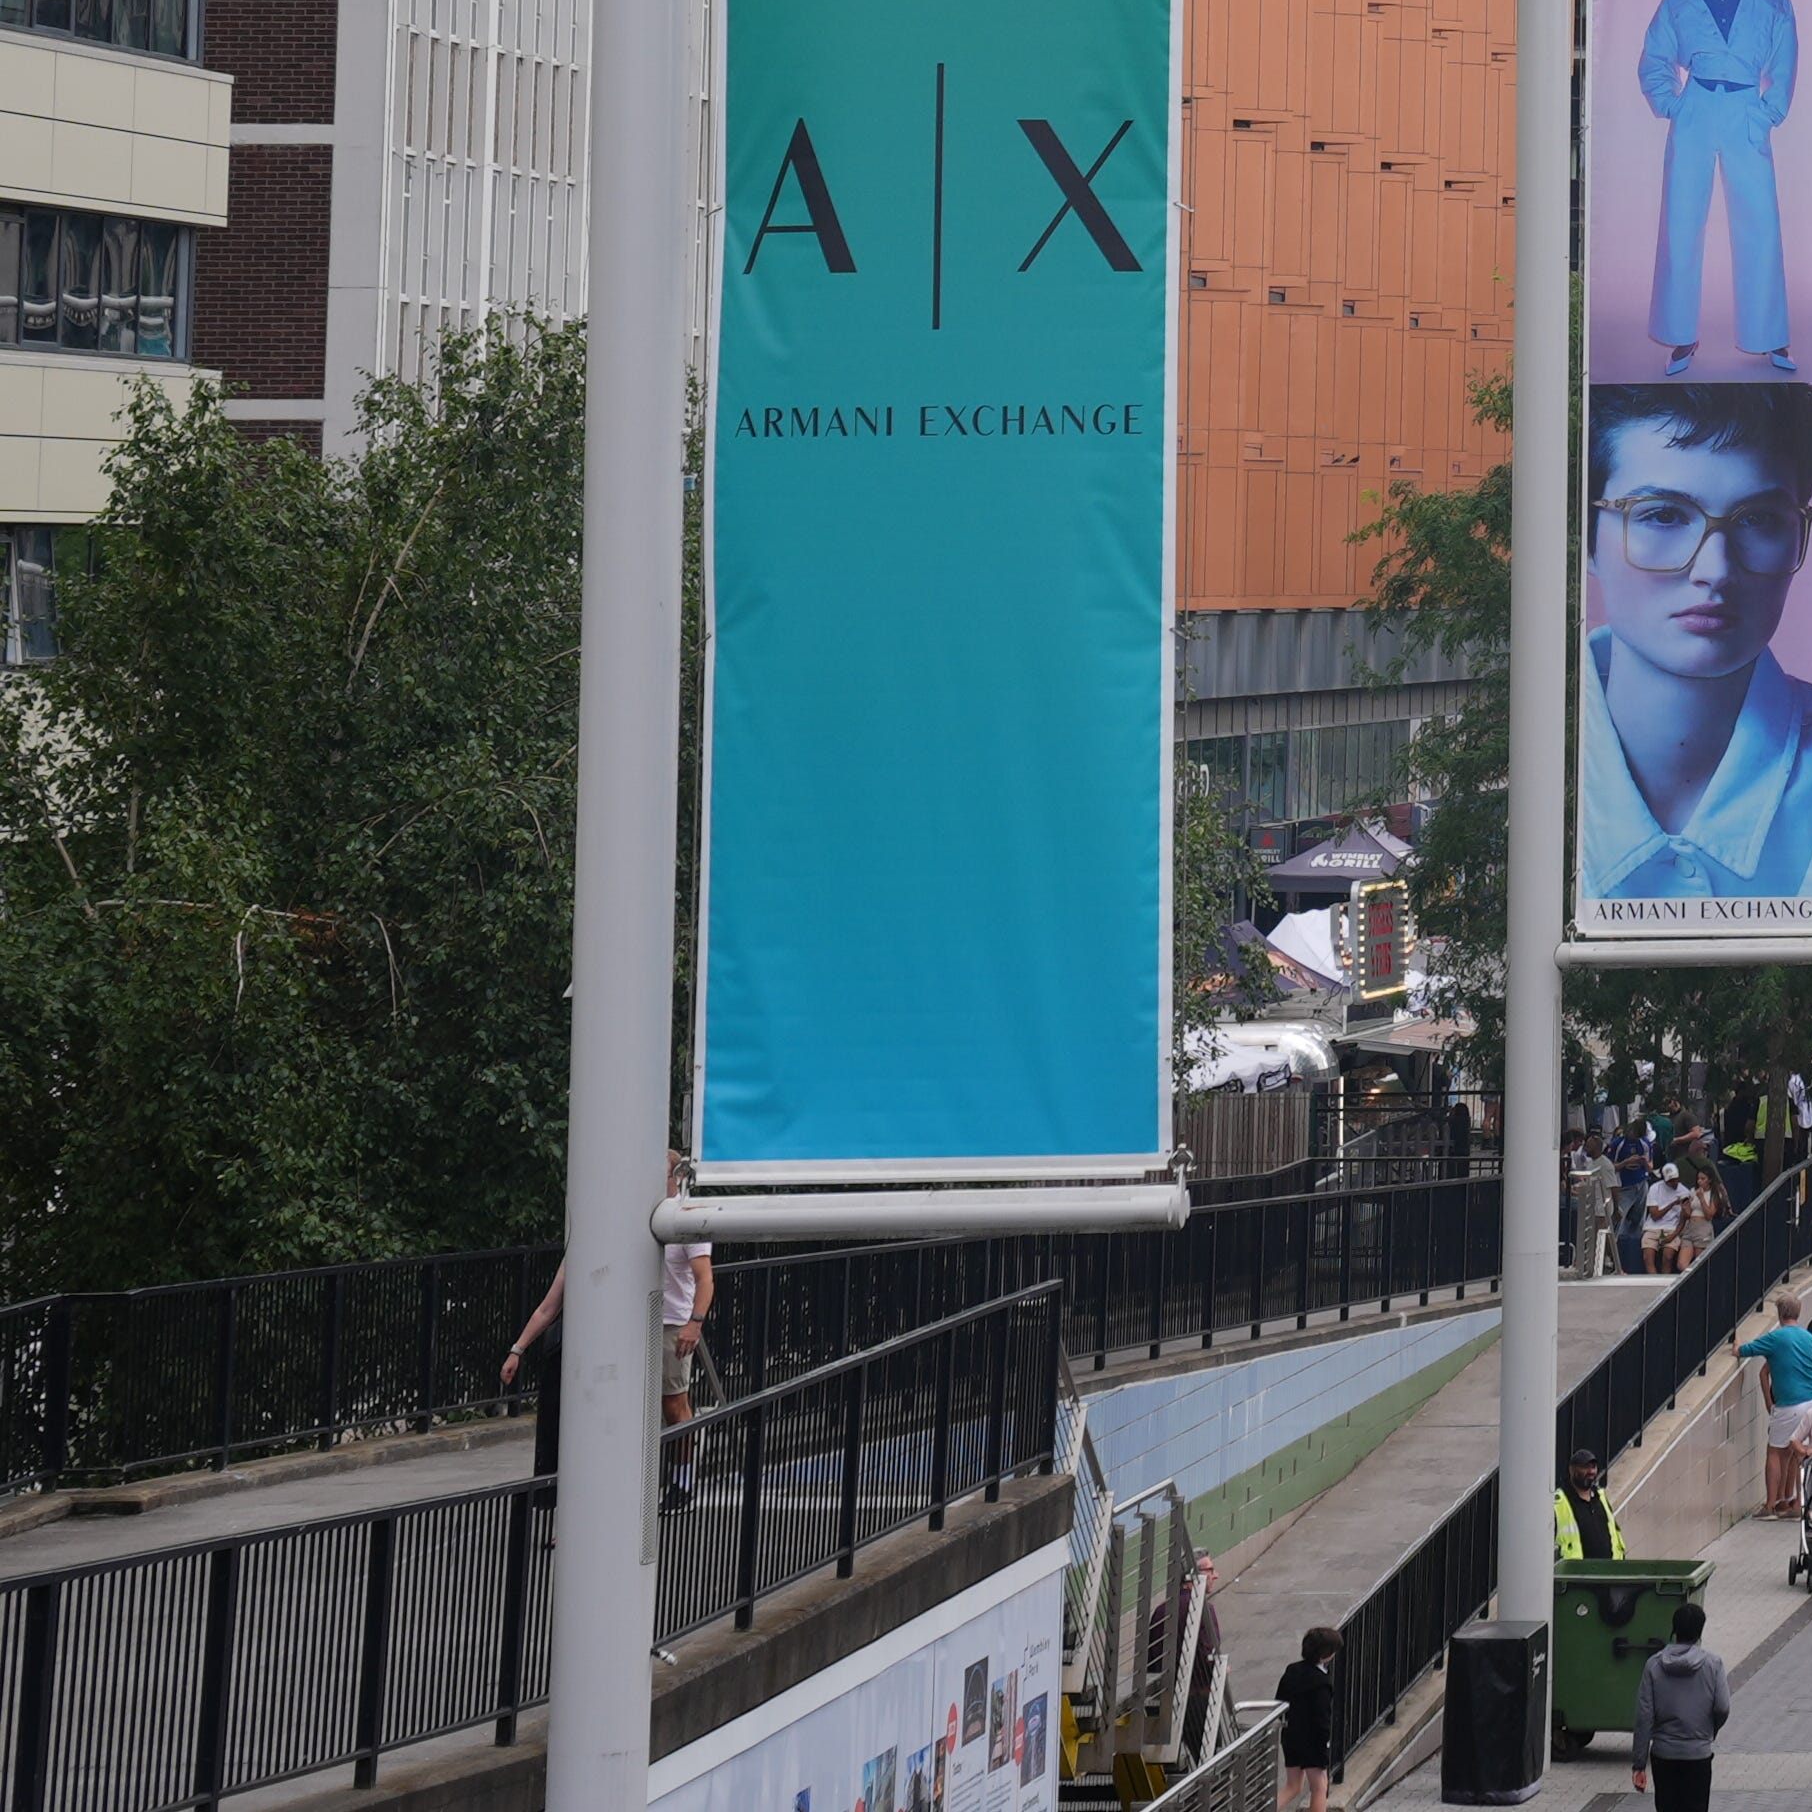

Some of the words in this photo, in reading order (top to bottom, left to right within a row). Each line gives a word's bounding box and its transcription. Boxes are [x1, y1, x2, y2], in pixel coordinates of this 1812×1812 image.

[735, 405, 893, 438] ARMANI
[919, 403, 1144, 437] EXCHANGE
[1328, 859, 1381, 869] GRILL
[1331, 853, 1383, 861] WEMBLEY
[1594, 901, 1687, 921] ARMANI
